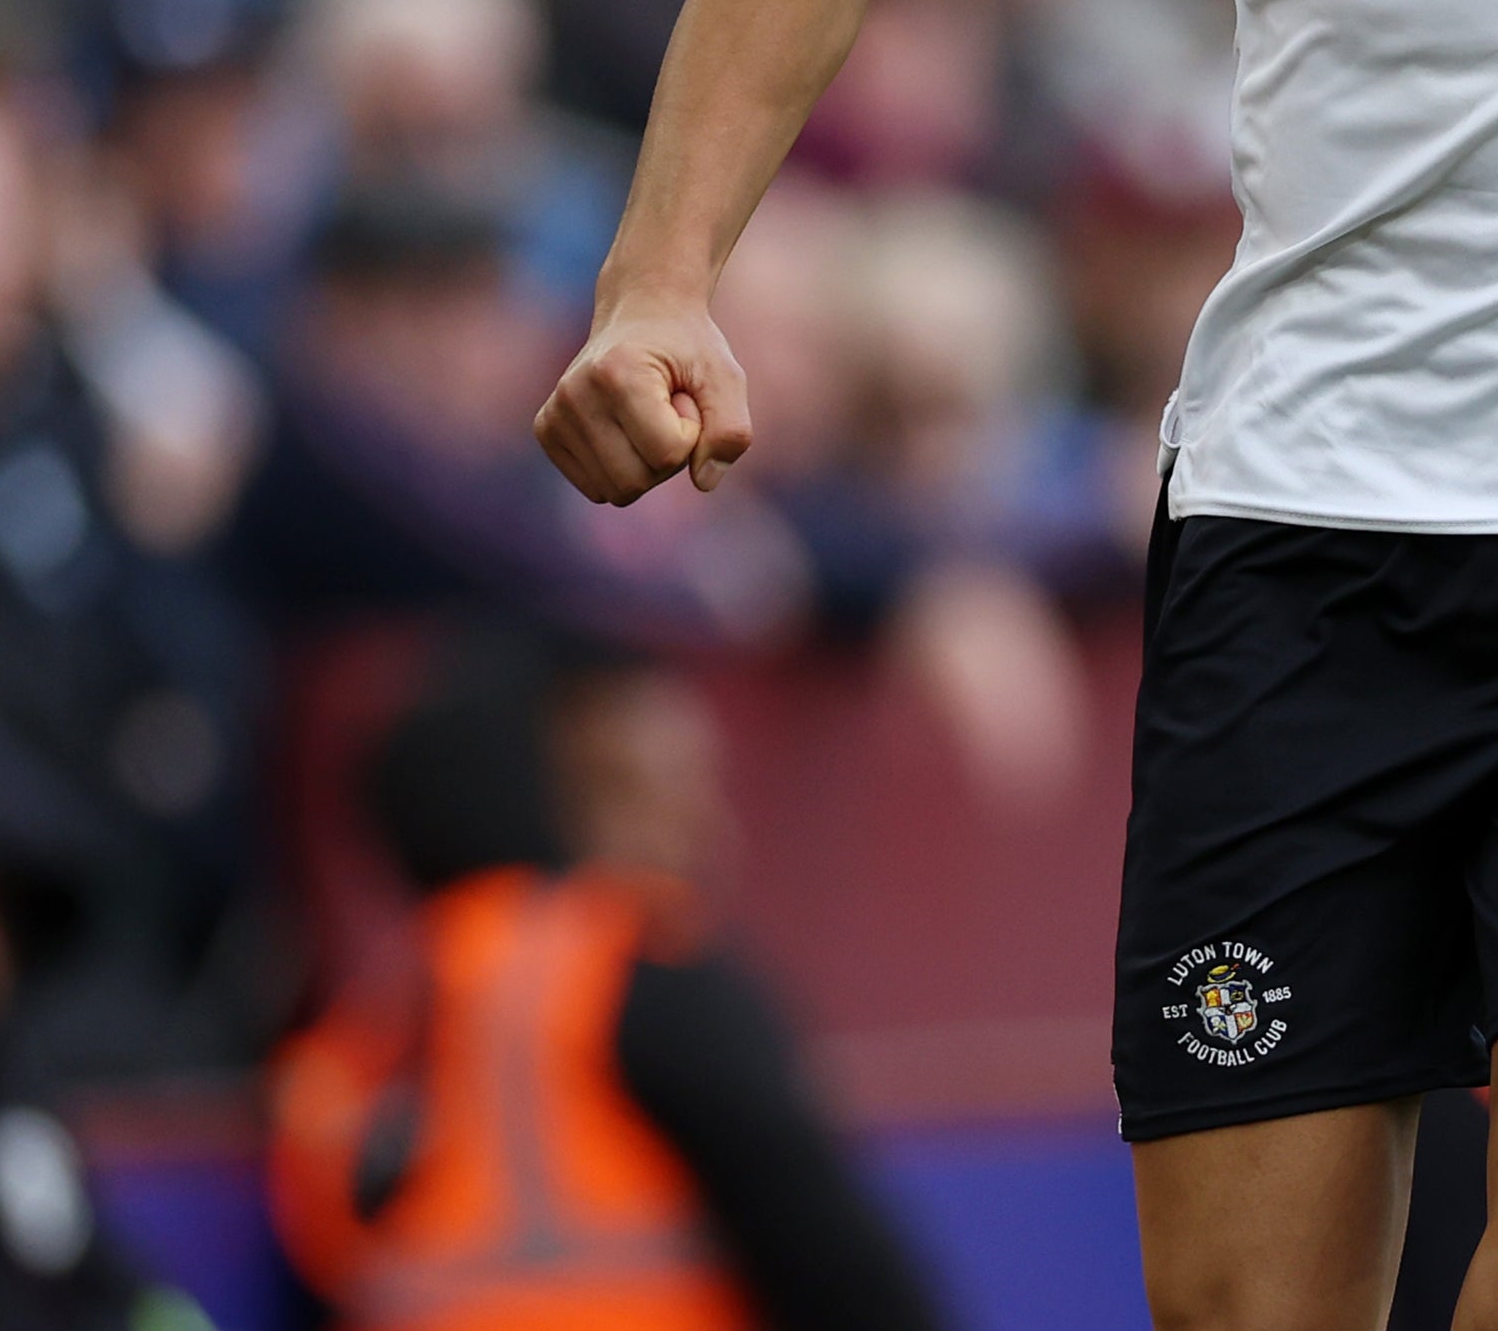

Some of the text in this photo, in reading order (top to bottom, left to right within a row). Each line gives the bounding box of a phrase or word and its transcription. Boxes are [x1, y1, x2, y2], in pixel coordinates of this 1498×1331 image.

[1167, 941, 1274, 986] LUTON TOWN
[1162, 986, 1292, 1019] EST 1885
[1177, 1019, 1287, 1066] FOOTBALL CLUB
